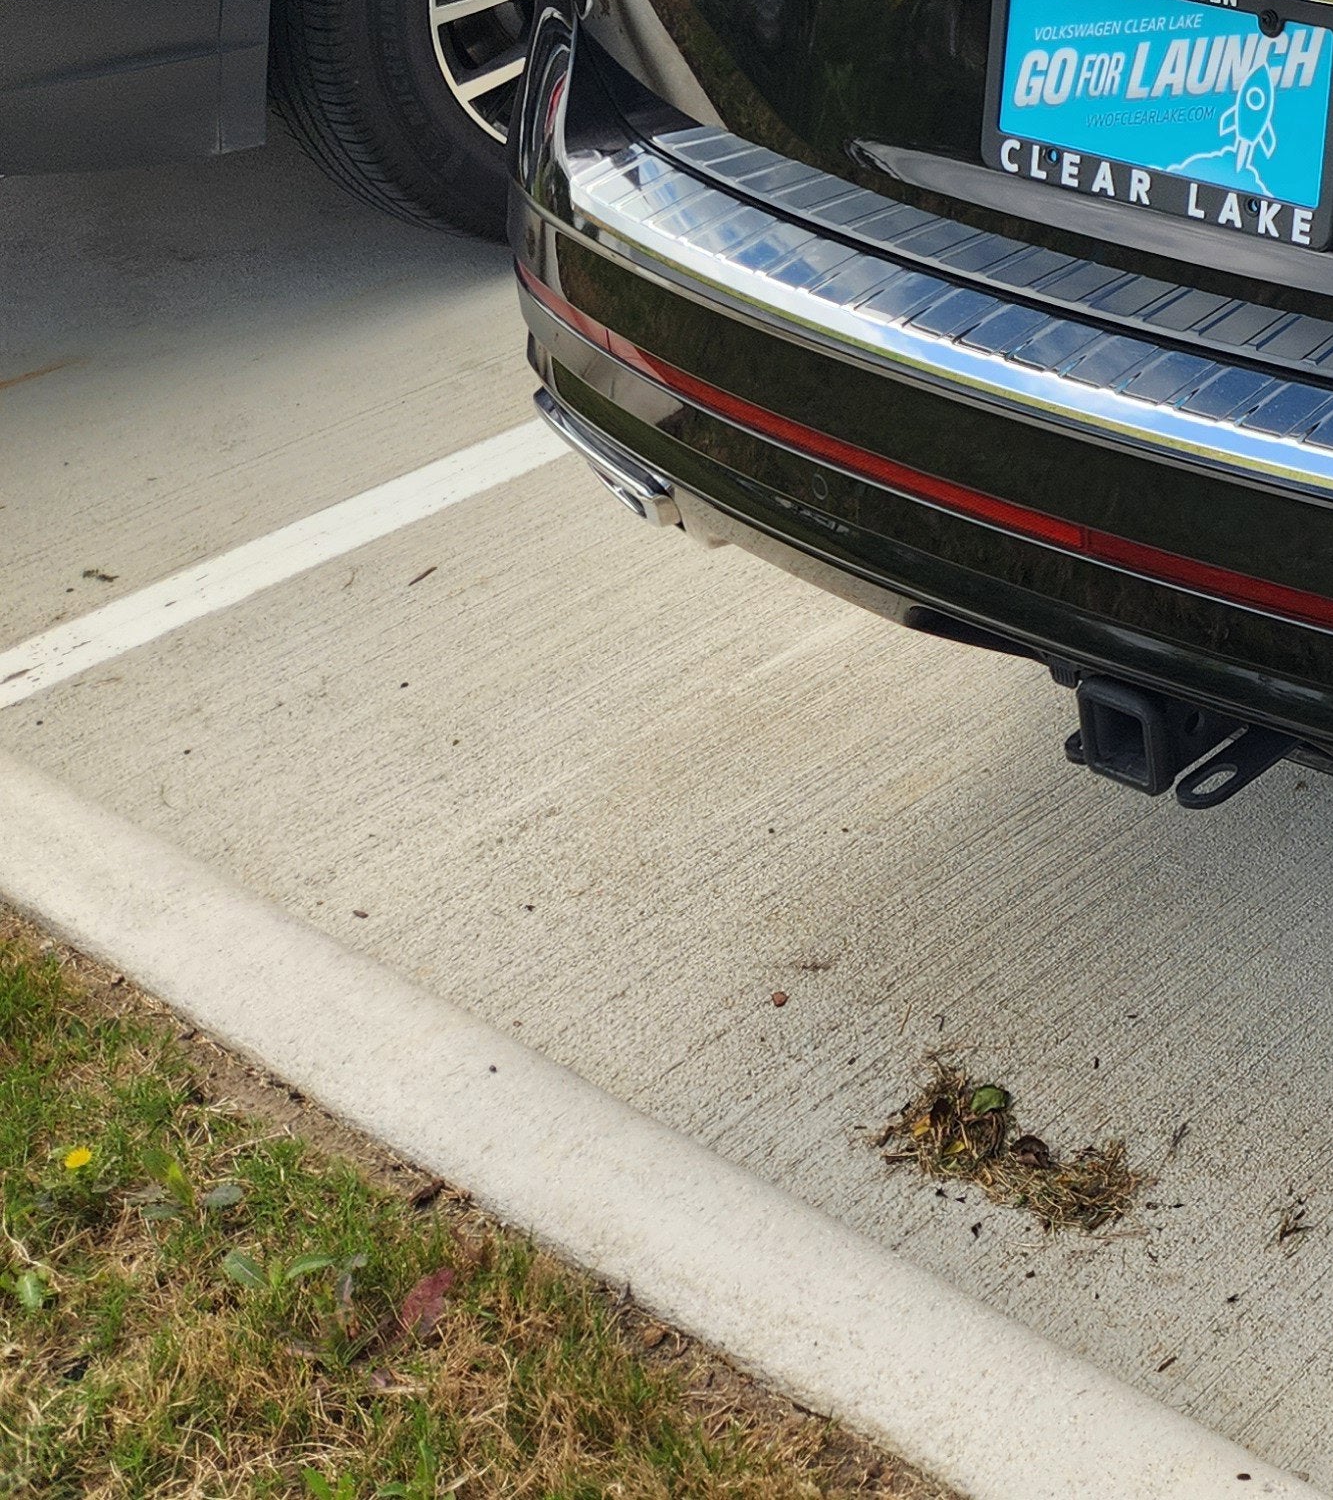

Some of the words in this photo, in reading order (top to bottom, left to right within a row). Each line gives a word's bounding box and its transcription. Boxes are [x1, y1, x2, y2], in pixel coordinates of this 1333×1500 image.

[1034, 20, 1121, 41] VOLKSWAGEN
[1124, 16, 1164, 35] CLEAR
[1168, 13, 1204, 30] LAKE
[1014, 47, 1078, 107] GO
[1076, 52, 1125, 97] FOR
[1125, 27, 1327, 100] LAUNCH
[1086, 106, 1216, 128] VWOFCLEARLAKE.COM
[1000, 139, 1151, 206] CLEAR
[1187, 182, 1314, 246] LAKE
